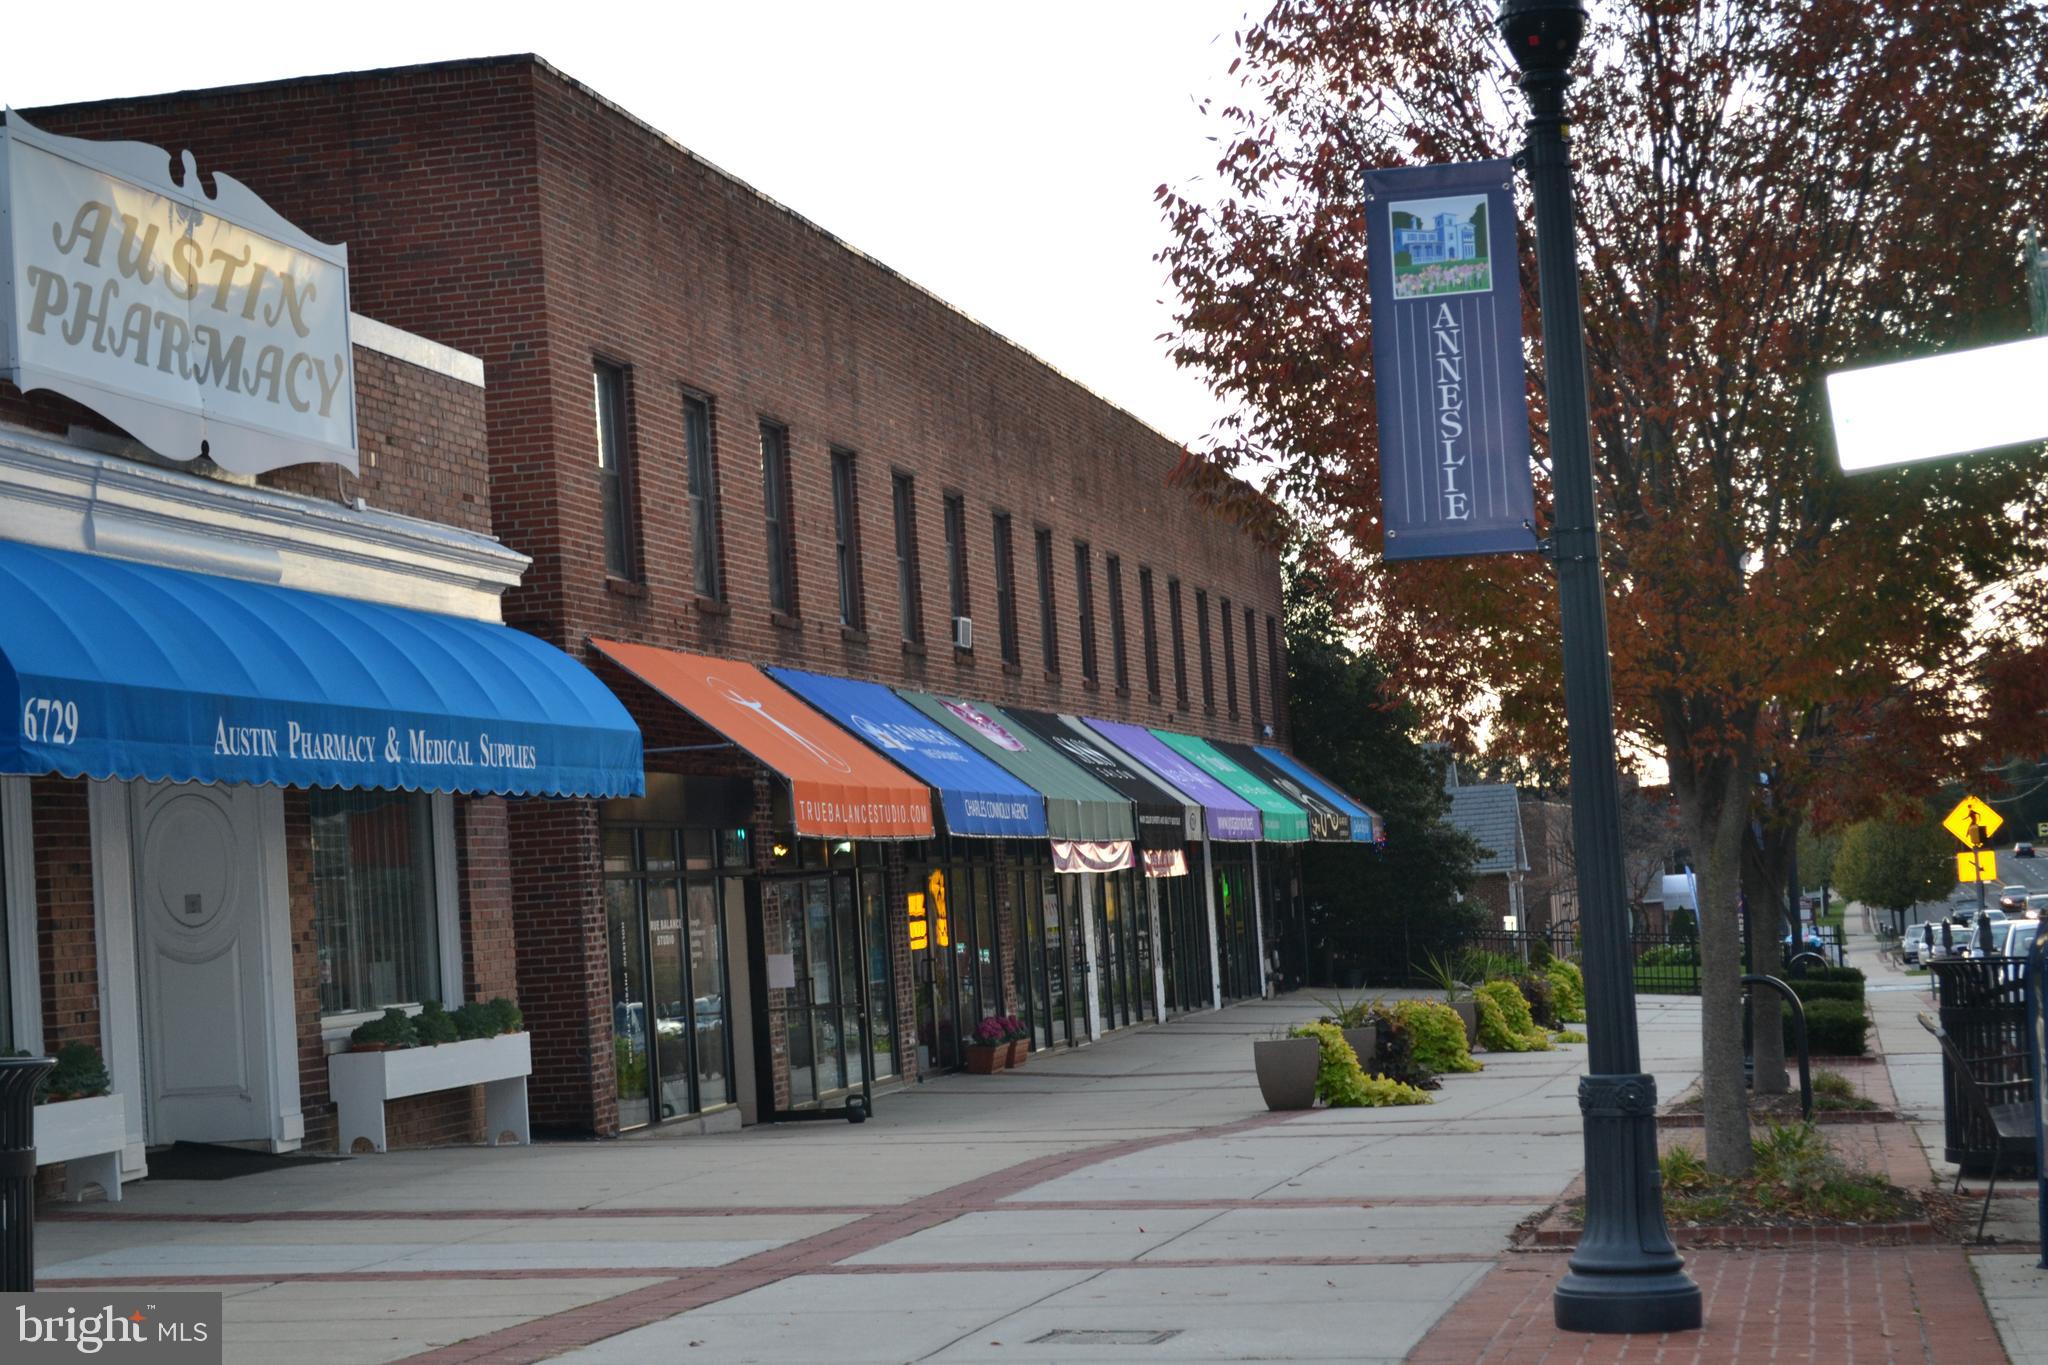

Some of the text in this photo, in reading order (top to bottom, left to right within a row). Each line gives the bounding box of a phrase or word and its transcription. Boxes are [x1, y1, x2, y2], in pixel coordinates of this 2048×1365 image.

[53, 200, 318, 339] AUSTIN
[27, 265, 343, 418] PHARMACY
[1432, 302, 1470, 521] ANNESLIE
[23, 697, 79, 746] 6729
[214, 716, 537, 771] AUSTIN PHARMACY & MEDICAL SUPPLIES
[799, 800, 928, 824] TRUEBALANCESTUDIO.COM
